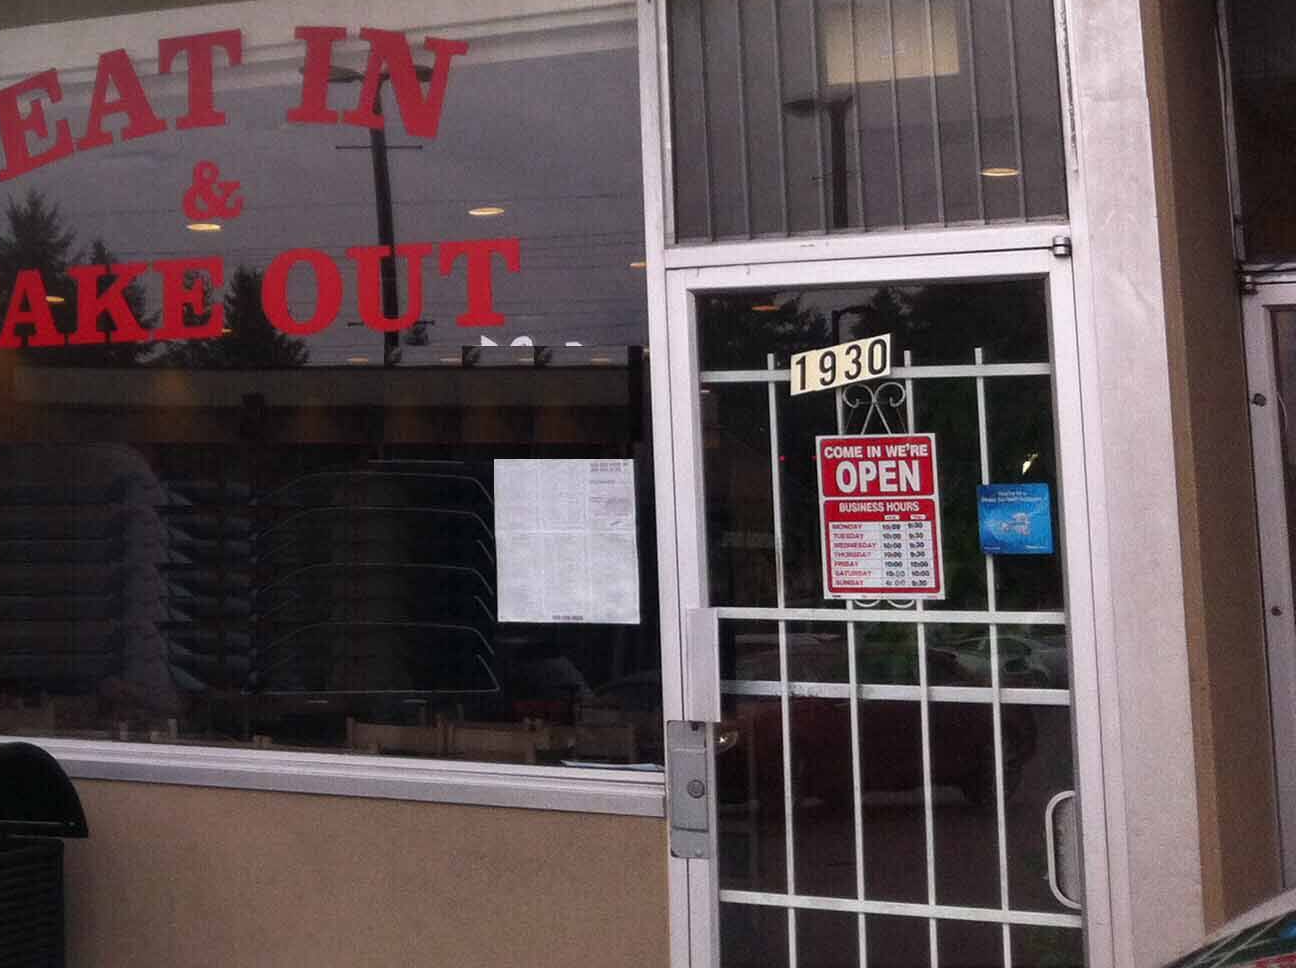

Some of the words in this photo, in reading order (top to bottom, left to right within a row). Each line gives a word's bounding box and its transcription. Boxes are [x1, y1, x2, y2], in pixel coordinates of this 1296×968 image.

[287, 26, 469, 139] IN
[181, 160, 245, 221] &
[261, 238, 521, 336] OUT
[795, 338, 887, 391] 1930
[824, 446, 863, 458] COME
[867, 445, 881, 457] IN
[885, 443, 928, 457] WE'RE
[835, 459, 921, 493] OPEN
[839, 502, 884, 513] BUSINESS
[886, 501, 920, 512] HOURS
